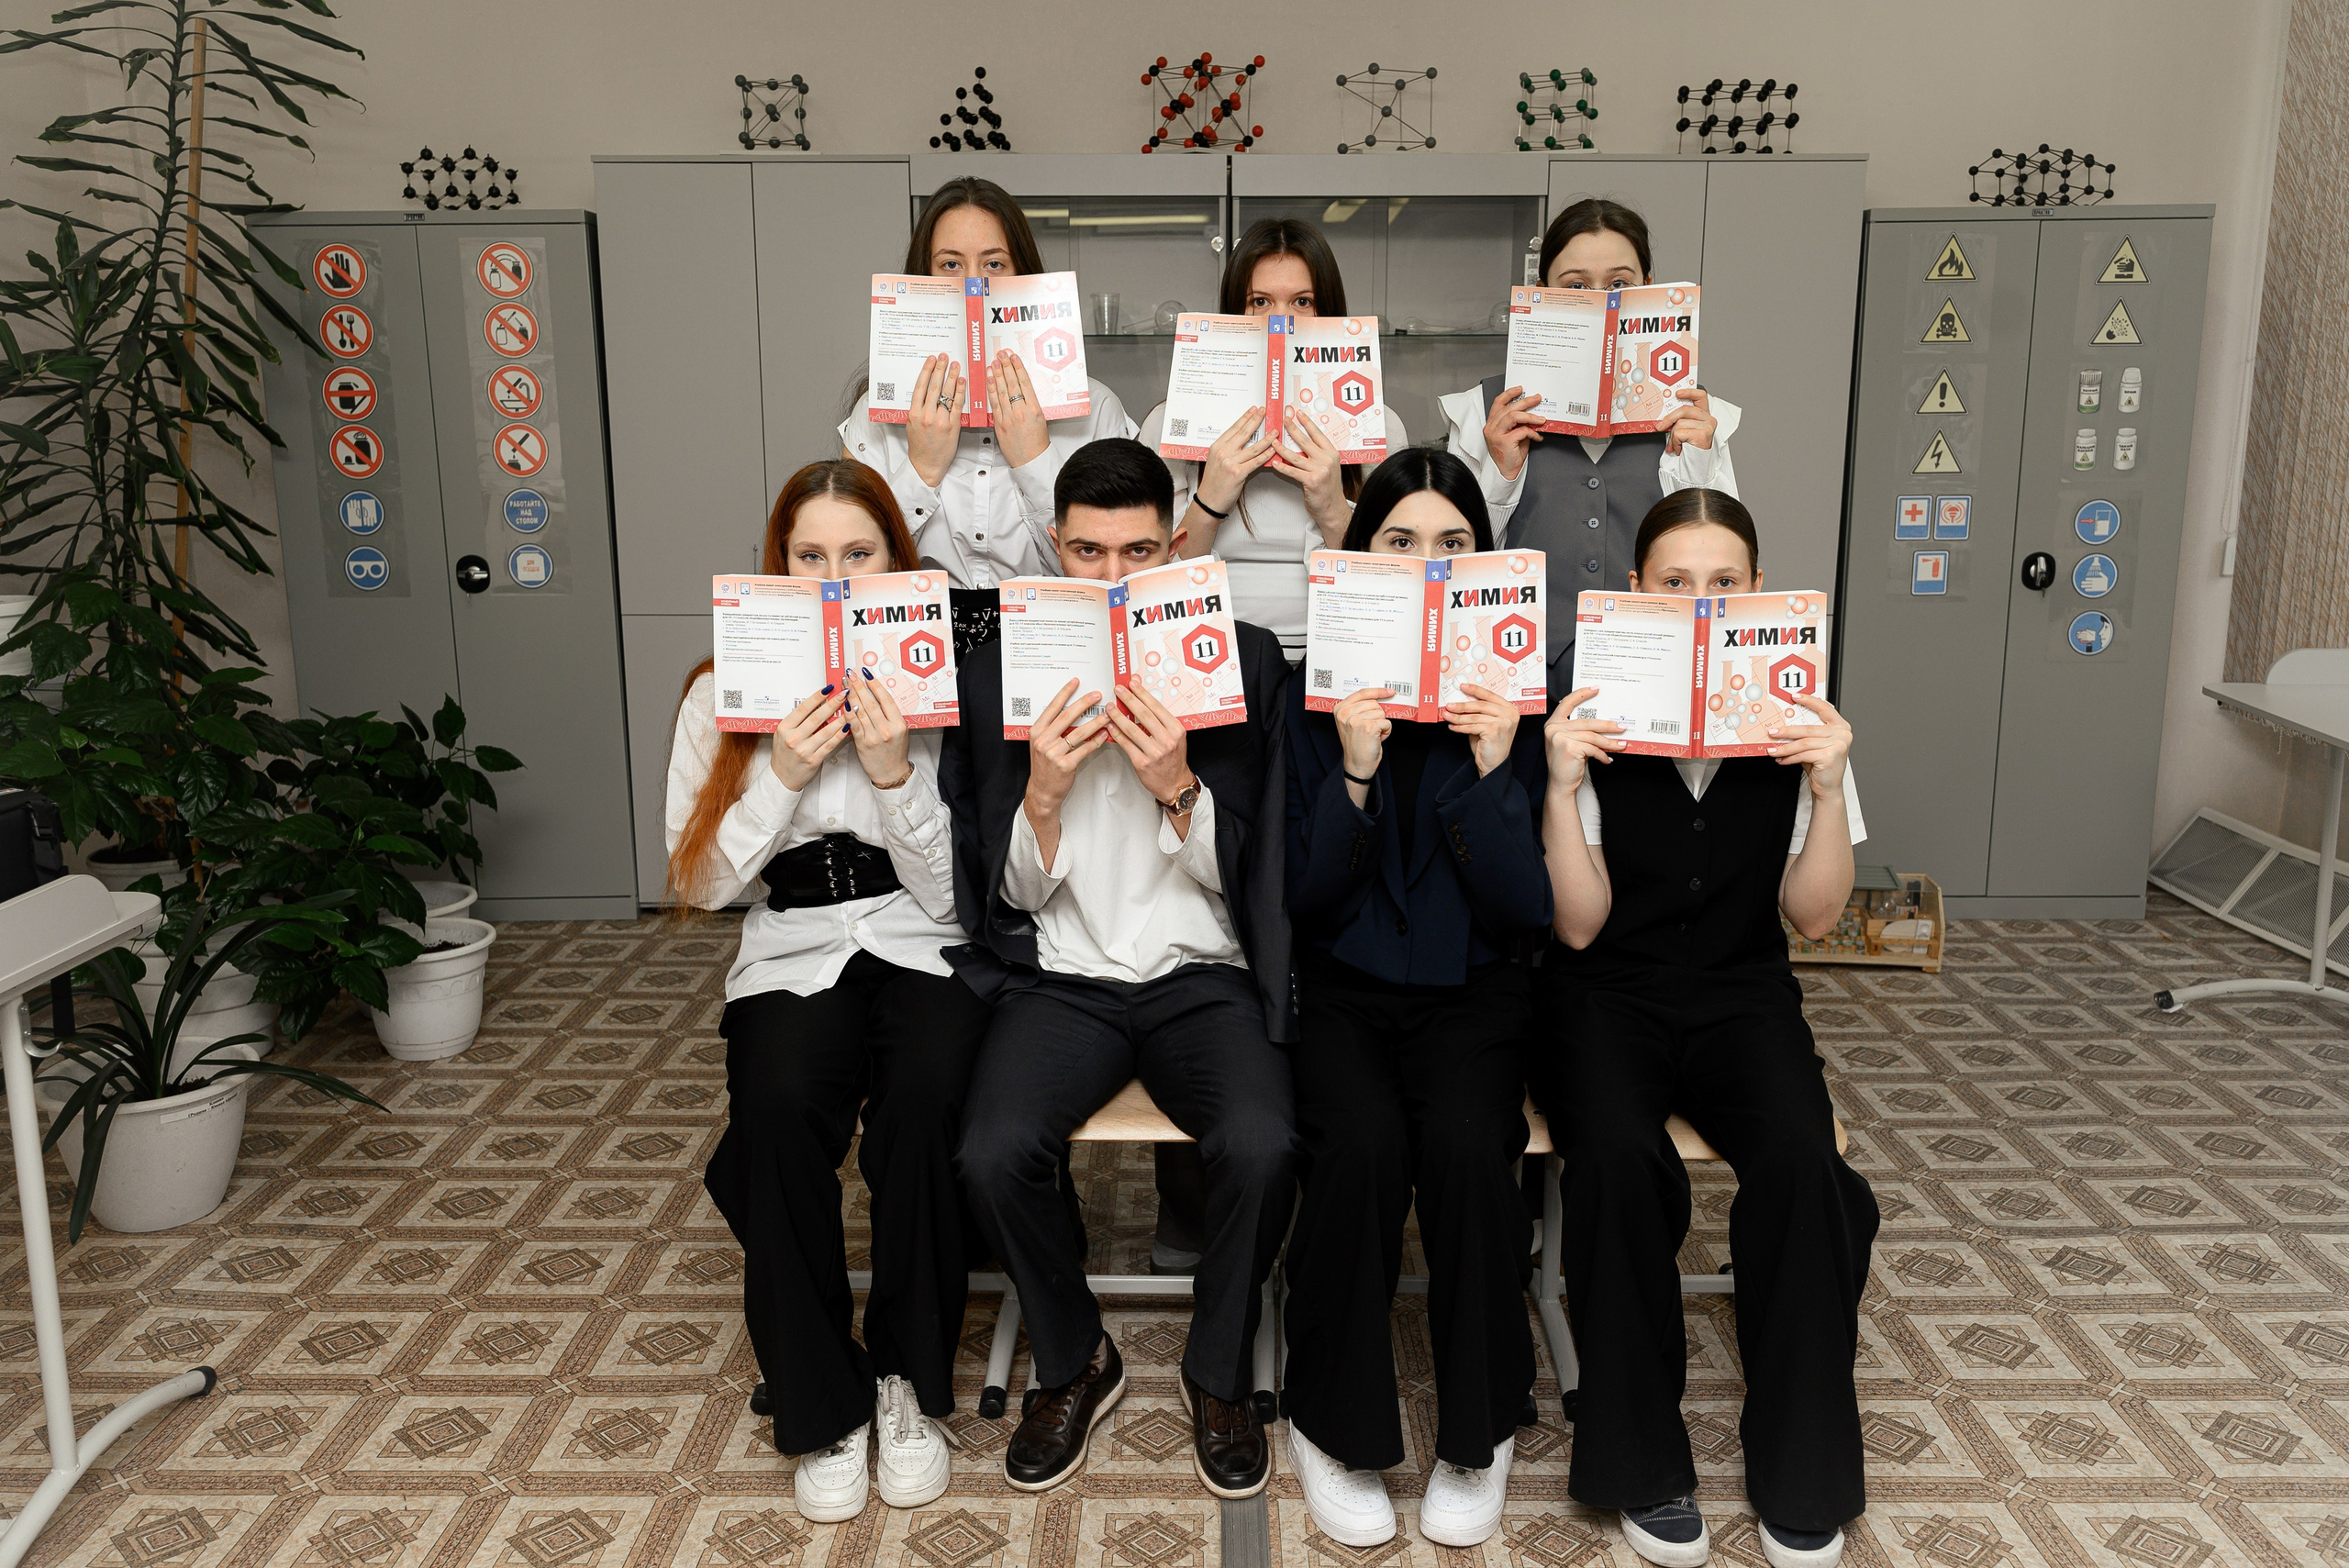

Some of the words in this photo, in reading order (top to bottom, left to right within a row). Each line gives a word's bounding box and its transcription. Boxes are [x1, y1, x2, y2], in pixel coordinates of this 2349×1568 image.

[991, 302, 1072, 323] ХИМИЯ
[1620, 316, 1690, 335] ХИМИЯ
[972, 321, 980, 361] ХИМИЯ
[1046, 343, 1065, 357] 11
[1294, 346, 1371, 362] ХИМИЯ
[1605, 334, 1614, 374] ХИМИЯ
[1661, 356, 1679, 371] 11
[1271, 359, 1280, 399] ХИМИЯ
[1344, 386, 1363, 401] 11
[1451, 586, 1536, 608] ХИМИЯ
[852, 604, 941, 627] ХИМИЯ
[1132, 595, 1222, 628] ХИМИЯ
[1427, 607, 1438, 651] ХИМИЯ
[1505, 631, 1525, 647] 11
[1724, 627, 1816, 648] ХИМИЯ
[830, 627, 839, 669] ХИМИЯ
[913, 648, 933, 663] 11
[1116, 631, 1127, 675] ХИМИЯ
[1195, 640, 1217, 658] 11
[1696, 644, 1704, 688] ХИМИЯ
[1783, 672, 1803, 688] 11
[1423, 695, 1433, 703] 11
